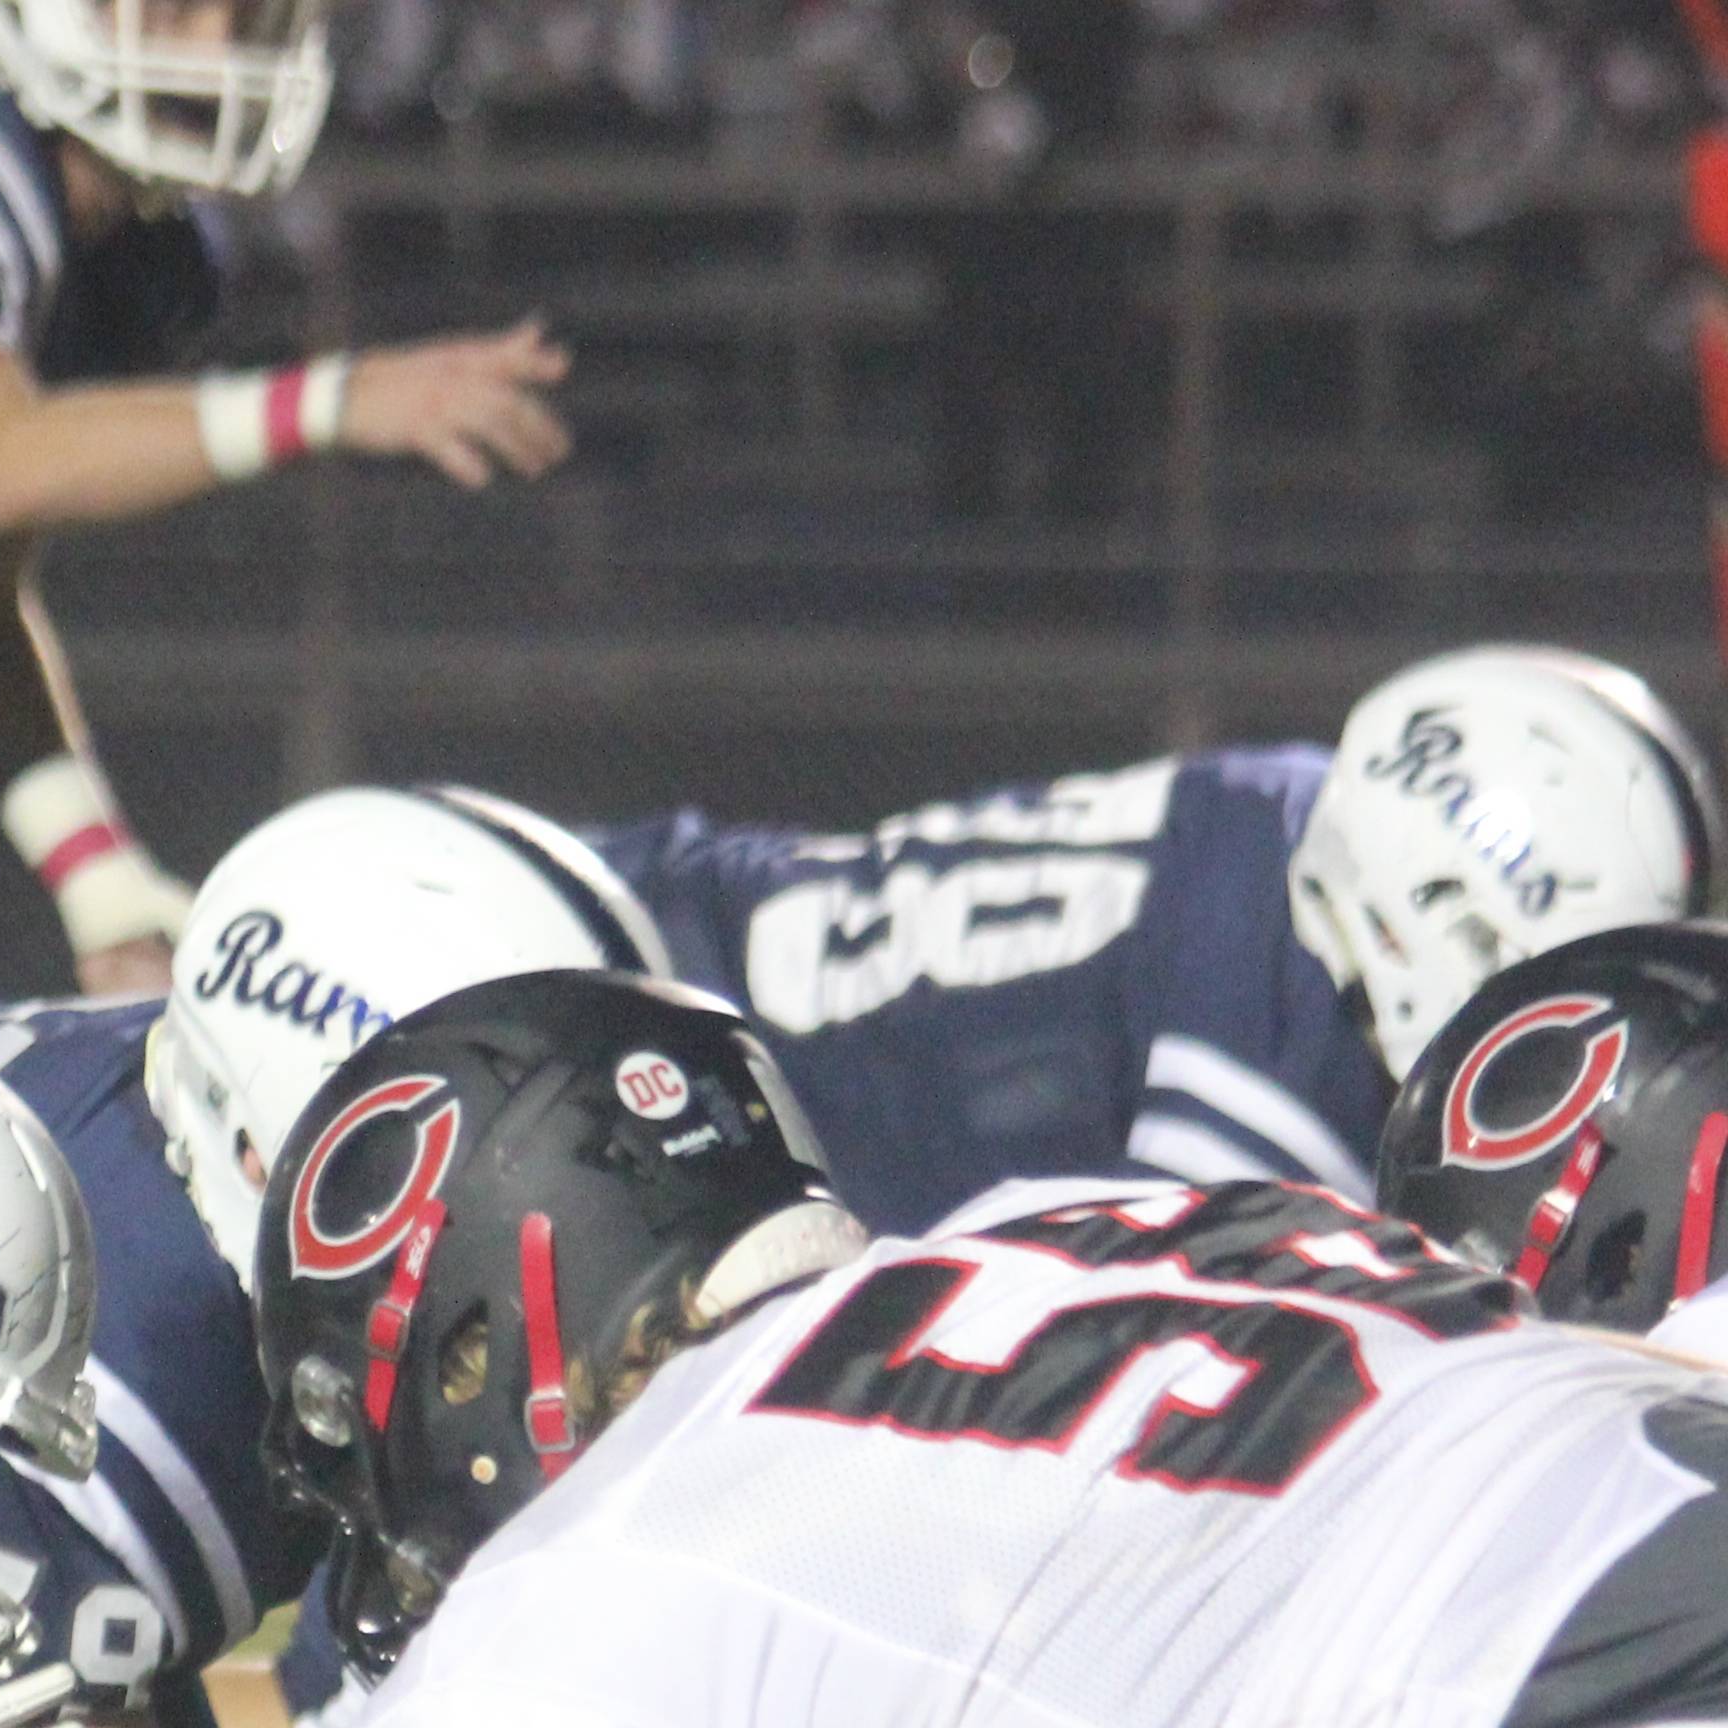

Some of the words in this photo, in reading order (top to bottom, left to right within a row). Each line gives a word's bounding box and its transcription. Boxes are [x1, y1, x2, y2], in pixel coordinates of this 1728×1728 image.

[1364, 700, 1562, 917] Rams
[195, 909, 394, 1045] Ram
[621, 1060, 683, 1110] DC
